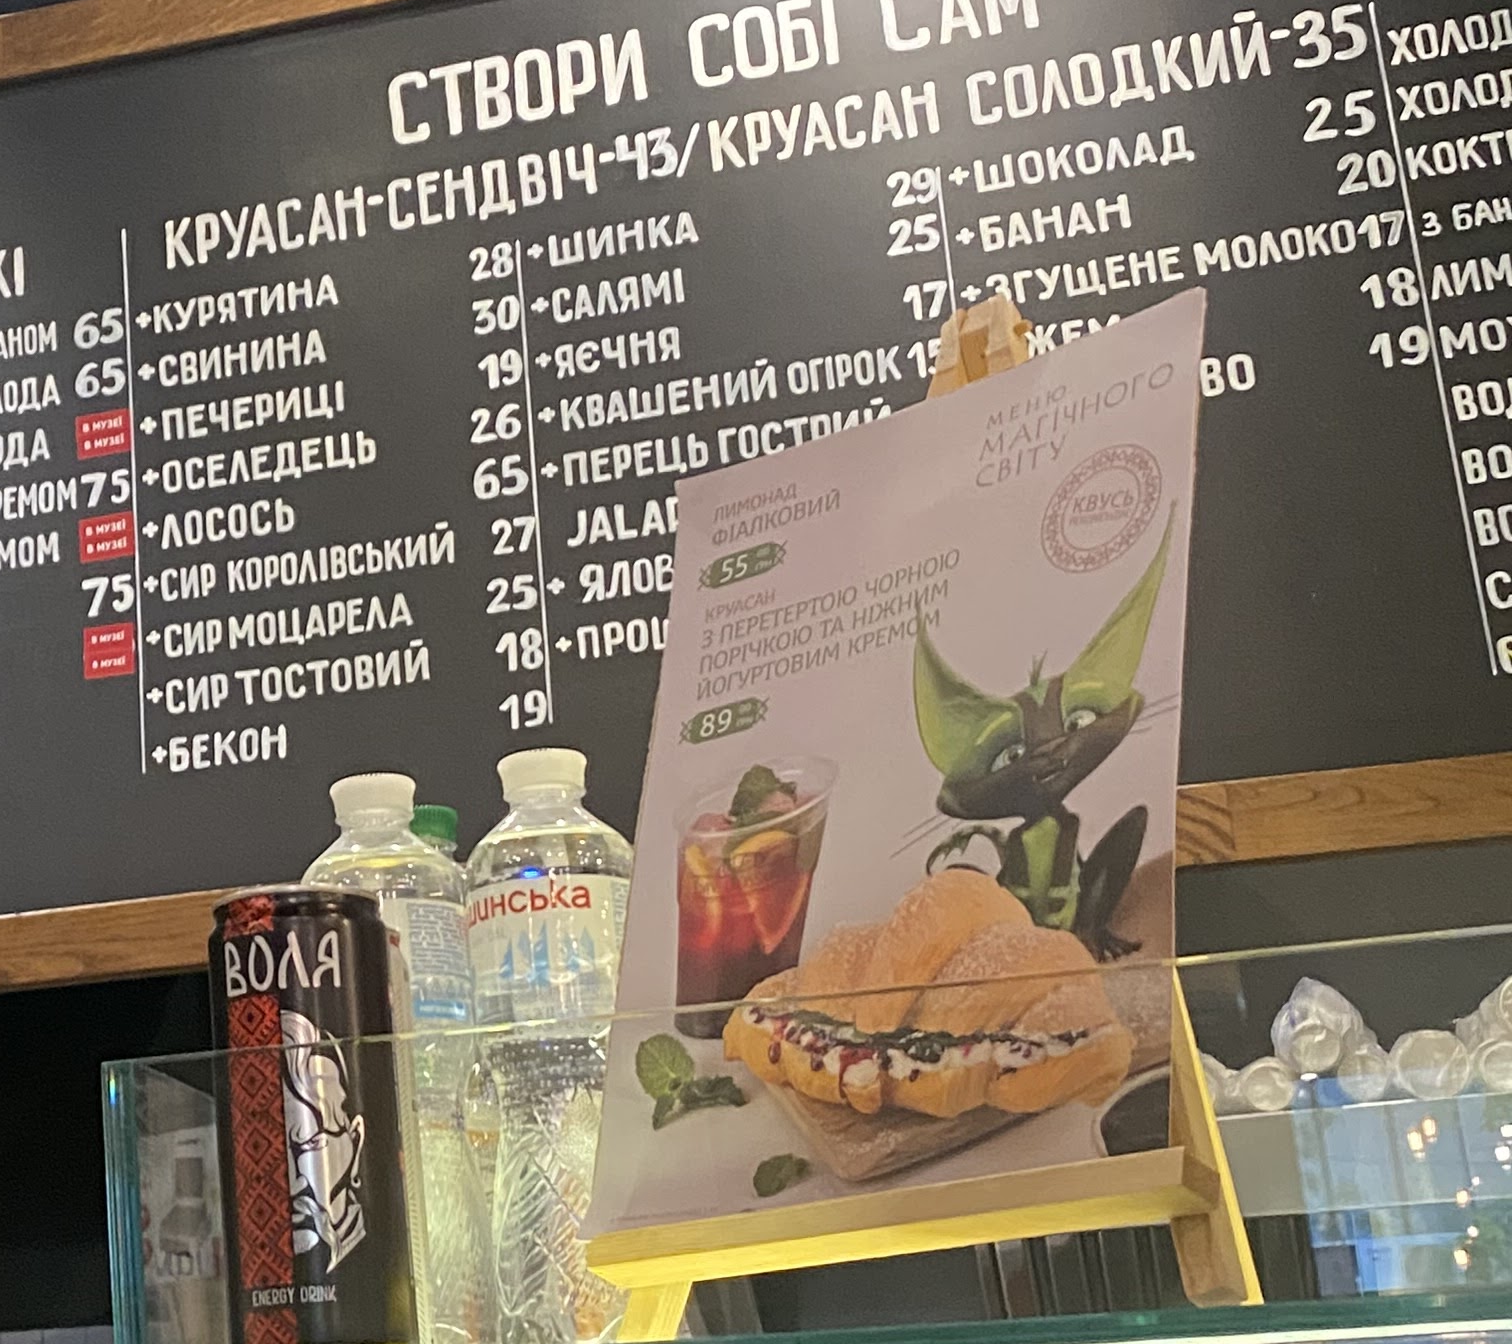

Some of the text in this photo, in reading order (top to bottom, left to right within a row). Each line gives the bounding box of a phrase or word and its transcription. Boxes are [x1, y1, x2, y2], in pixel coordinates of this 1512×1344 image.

[387, 27, 648, 147] СТВОРИ
[1304, 89, 1377, 144] 25
[887, 166, 942, 208] 29
[1337, 150, 1398, 197] 20
[888, 215, 940, 257] 25
[1194, 224, 1354, 278] МОЛОКО
[1356, 211, 1405, 249] 17
[469, 242, 514, 281] 28
[903, 279, 949, 322] 17
[1360, 266, 1423, 312] 18
[73, 308, 125, 350] 65
[473, 298, 520, 336] 30
[478, 353, 523, 390] 19
[1368, 331, 1430, 370] 19
[74, 357, 127, 398] 65
[789, 347, 902, 398] ОГІРОК
[470, 408, 522, 444] 26
[979, 363, 1173, 461] МАГІЧНОГО
[987, 386, 1067, 429] МЕНЮ
[473, 459, 530, 498] 65
[976, 434, 1066, 487] СВІТУ
[83, 471, 131, 513] 75
[714, 483, 797, 524] ЛИМОНАД
[712, 488, 841, 546] ФІАЛКОВИЙ
[227, 523, 457, 593] КОРОЛІВСЬКИЙ
[492, 515, 535, 556] 27
[720, 554, 748, 583] 55
[81, 576, 134, 617] 75
[228, 593, 414, 655] МОЦАРЕЛА
[486, 574, 538, 616] 25
[704, 589, 776, 623] КРУАСАН
[720, 548, 960, 643] ПЕРЕТЕРТОЮ ЧОРНОЮ
[699, 579, 948, 674] ПОРІЧКОЮ НІЖНИМ
[235, 640, 431, 706] ТОСТОВИЙ
[495, 629, 545, 673] 18
[696, 608, 940, 701] ЙОГУРТОВИМ КРЕМОМ
[499, 684, 549, 730] 19
[699, 708, 732, 738] 89
[223, 930, 342, 999] ВОЛЯ
[253, 1284, 337, 1307] ENERGY DRINK
